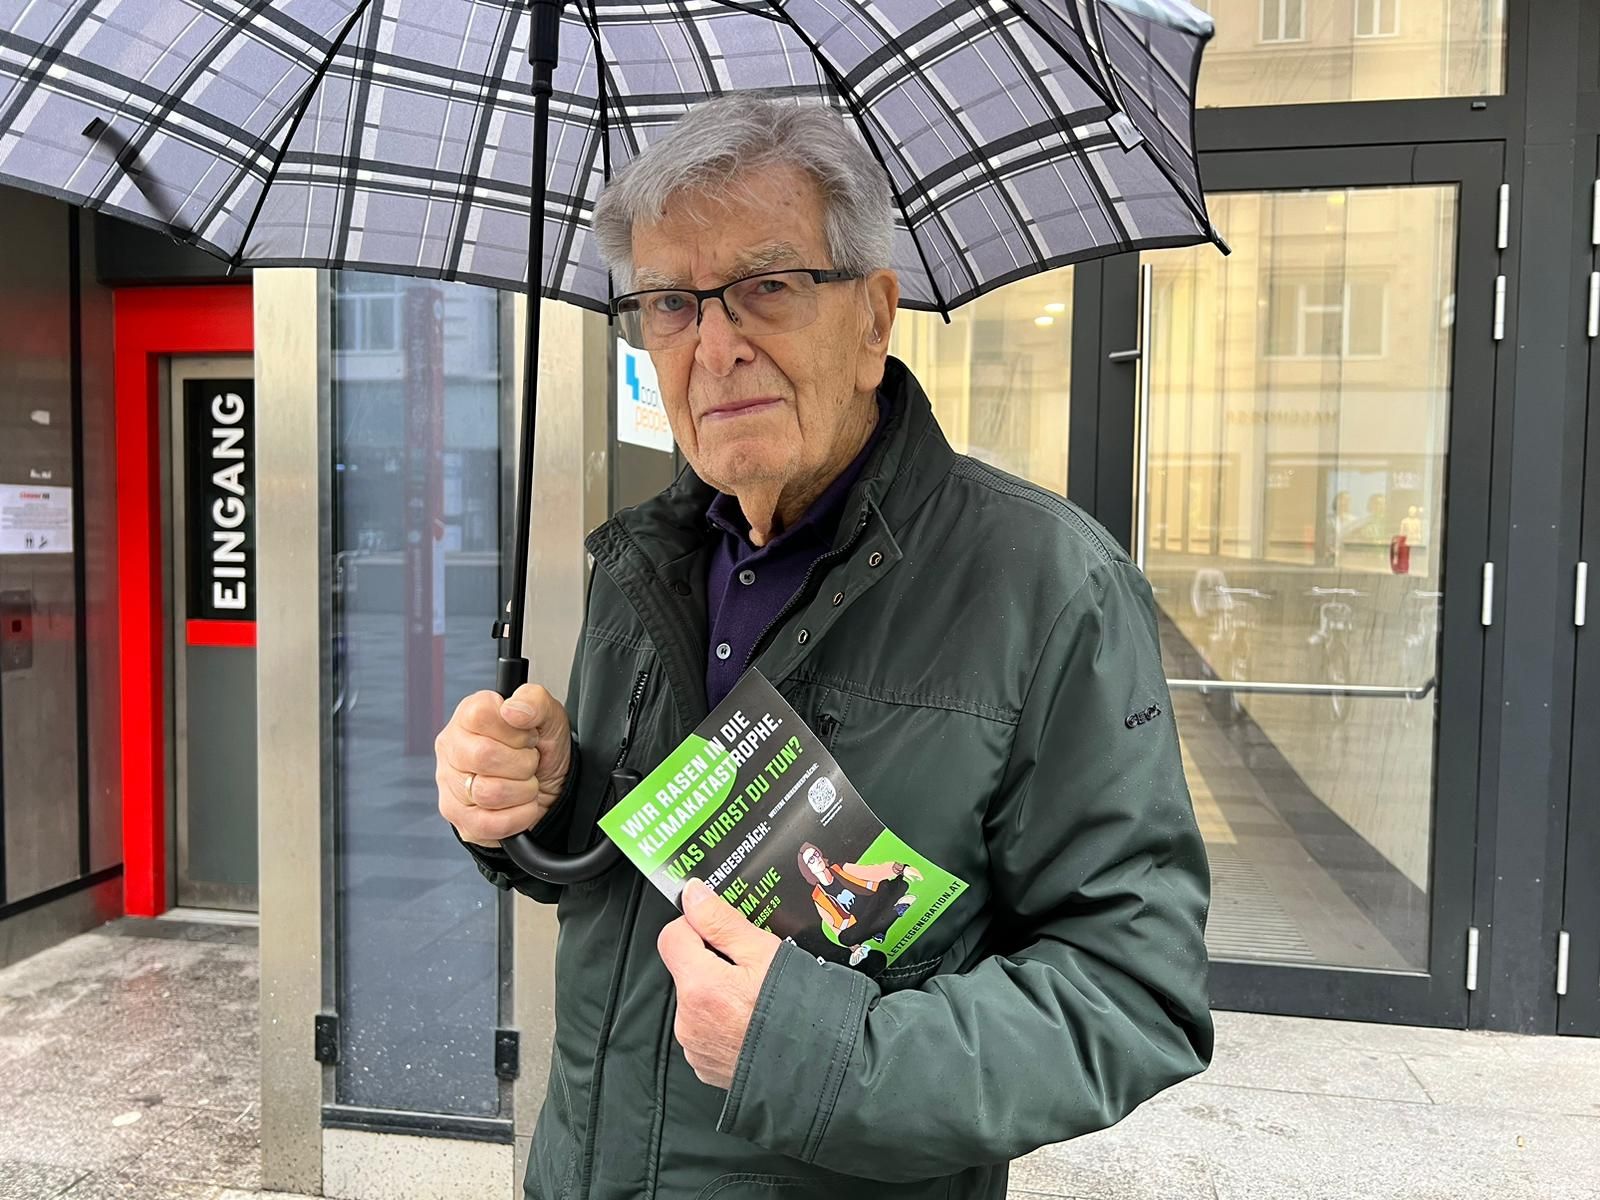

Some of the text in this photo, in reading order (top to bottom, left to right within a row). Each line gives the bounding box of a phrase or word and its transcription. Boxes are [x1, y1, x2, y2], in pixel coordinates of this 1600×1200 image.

[211, 392, 246, 610] EINGANG
[620, 710, 751, 839] WIR RASEN IN DIE
[637, 713, 783, 858] KLIMAKATASTROPHE.
[662, 735, 804, 884] WAS WIRST DU TUN?
[753, 904, 774, 928] GASSE
[754, 866, 781, 899] LIVE
[887, 881, 962, 957] LETZTEGENERATION.AT
